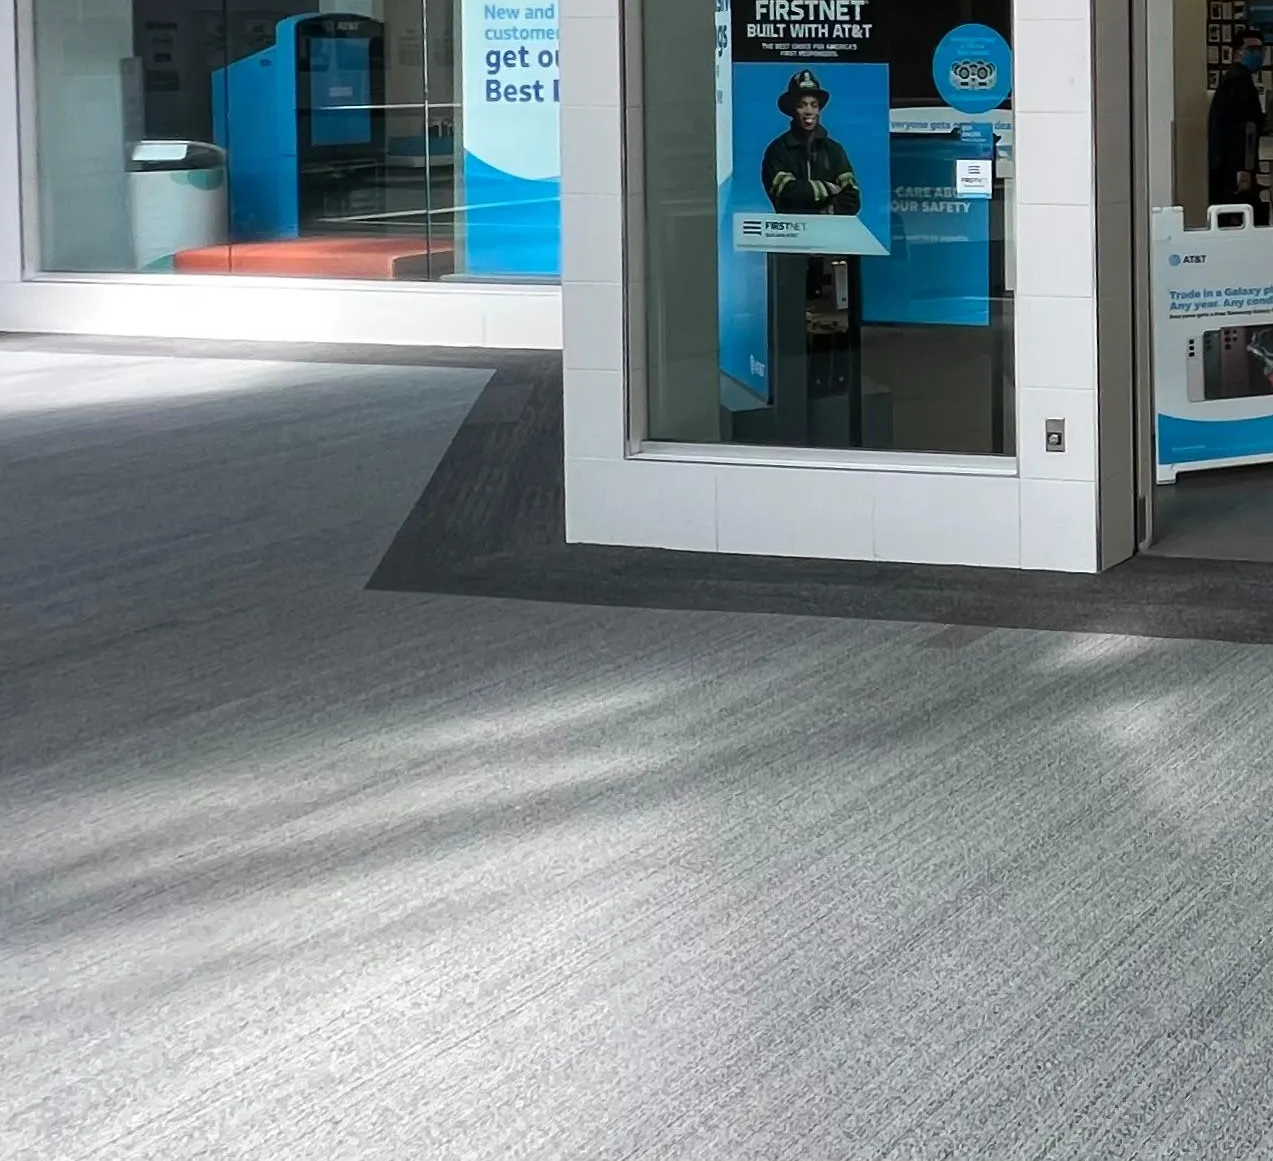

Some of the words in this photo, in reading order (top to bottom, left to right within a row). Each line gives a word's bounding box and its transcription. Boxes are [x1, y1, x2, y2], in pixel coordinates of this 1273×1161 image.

[484, 4, 520, 20] New
[524, 2, 555, 20] and
[755, 0, 869, 21] FIRSTNET
[746, 23, 787, 38] BUILT
[789, 23, 829, 38] WITH
[832, 23, 873, 39] AT&T
[485, 45, 530, 76] get
[537, 49, 560, 69] o
[485, 79, 545, 102] Best
[890, 122, 929, 131] veryone
[994, 121, 1011, 130] dea
[895, 186, 931, 199] CARE
[933, 187, 957, 199] AB
[890, 200, 919, 213] OUR
[921, 201, 972, 214] SAFETY
[765, 221, 808, 231] FIRSTNET
[1182, 254, 1207, 264] AT&T
[1169, 288, 1201, 300] Trade
[1203, 287, 1214, 298] in
[1224, 286, 1262, 298] Galaxy
[1169, 301, 1193, 312] Any
[1193, 300, 1220, 311] year.
[1223, 297, 1246, 309] Any
